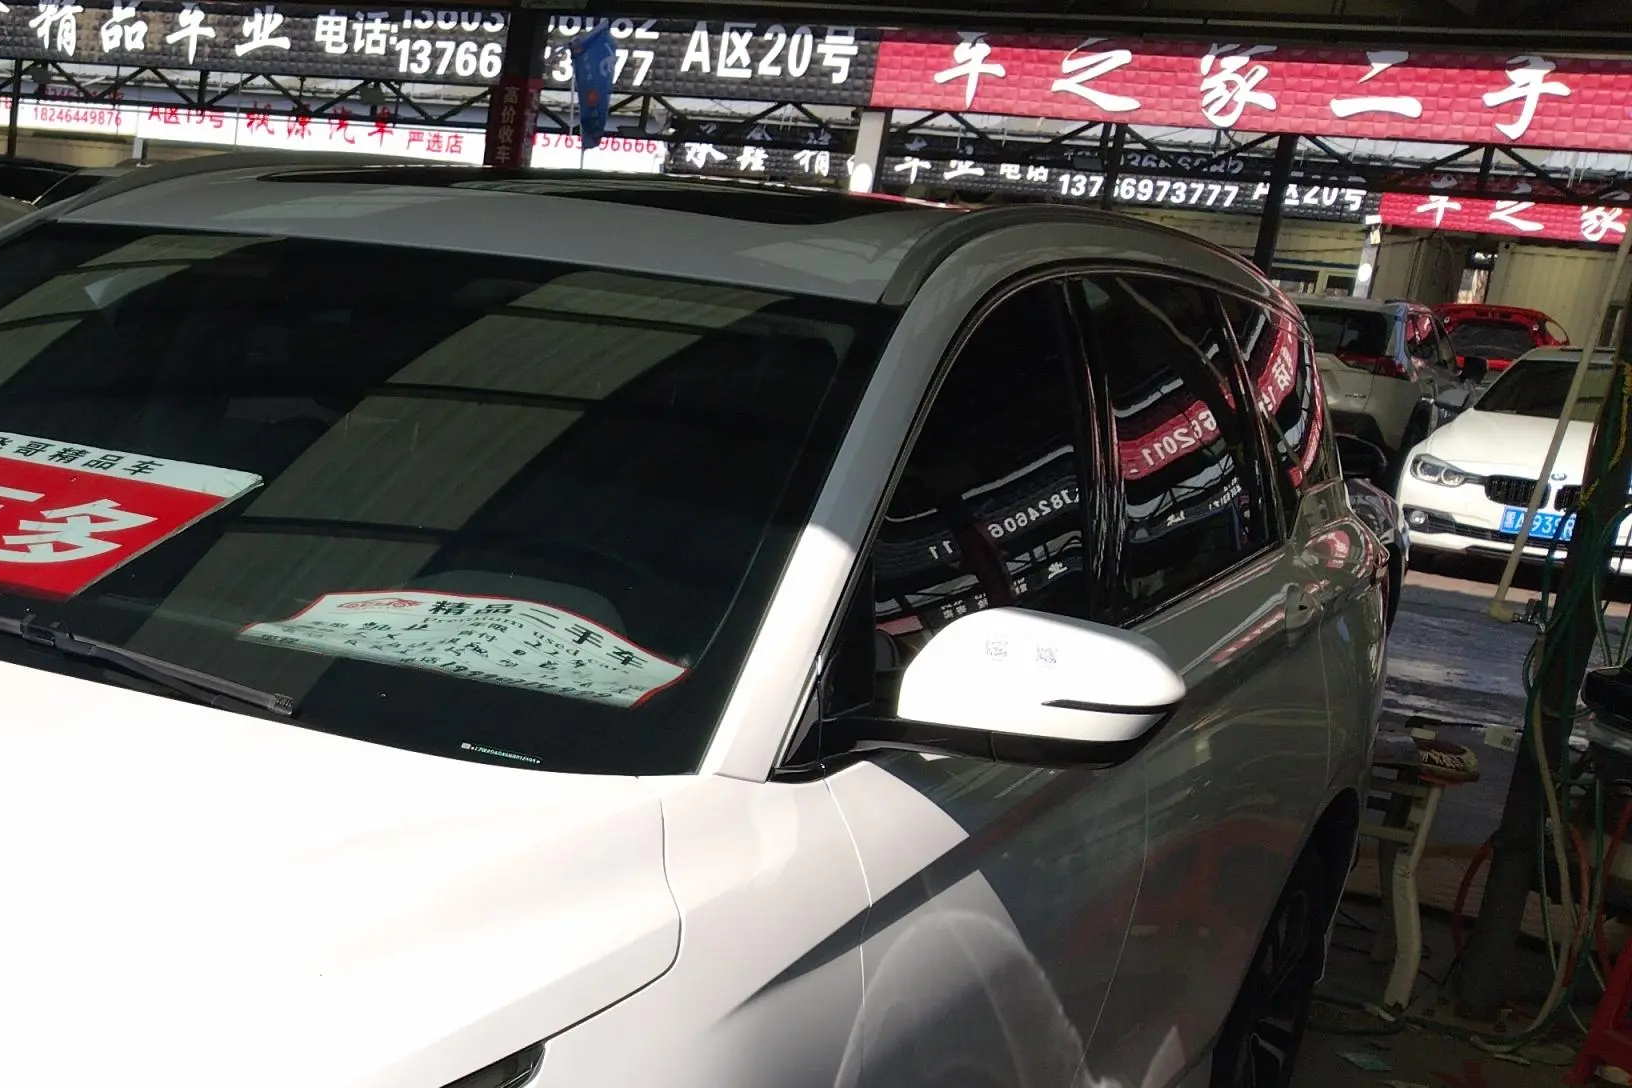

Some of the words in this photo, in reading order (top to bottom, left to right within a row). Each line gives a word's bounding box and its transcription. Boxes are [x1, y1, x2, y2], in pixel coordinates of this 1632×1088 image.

[680, 20, 858, 84] A区20号
[32, 107, 122, 126] 18246449876
[934, 31, 1572, 139] 车之家二手
[406, 130, 464, 154] 严选店
[428, 600, 648, 668] 精品二手车
